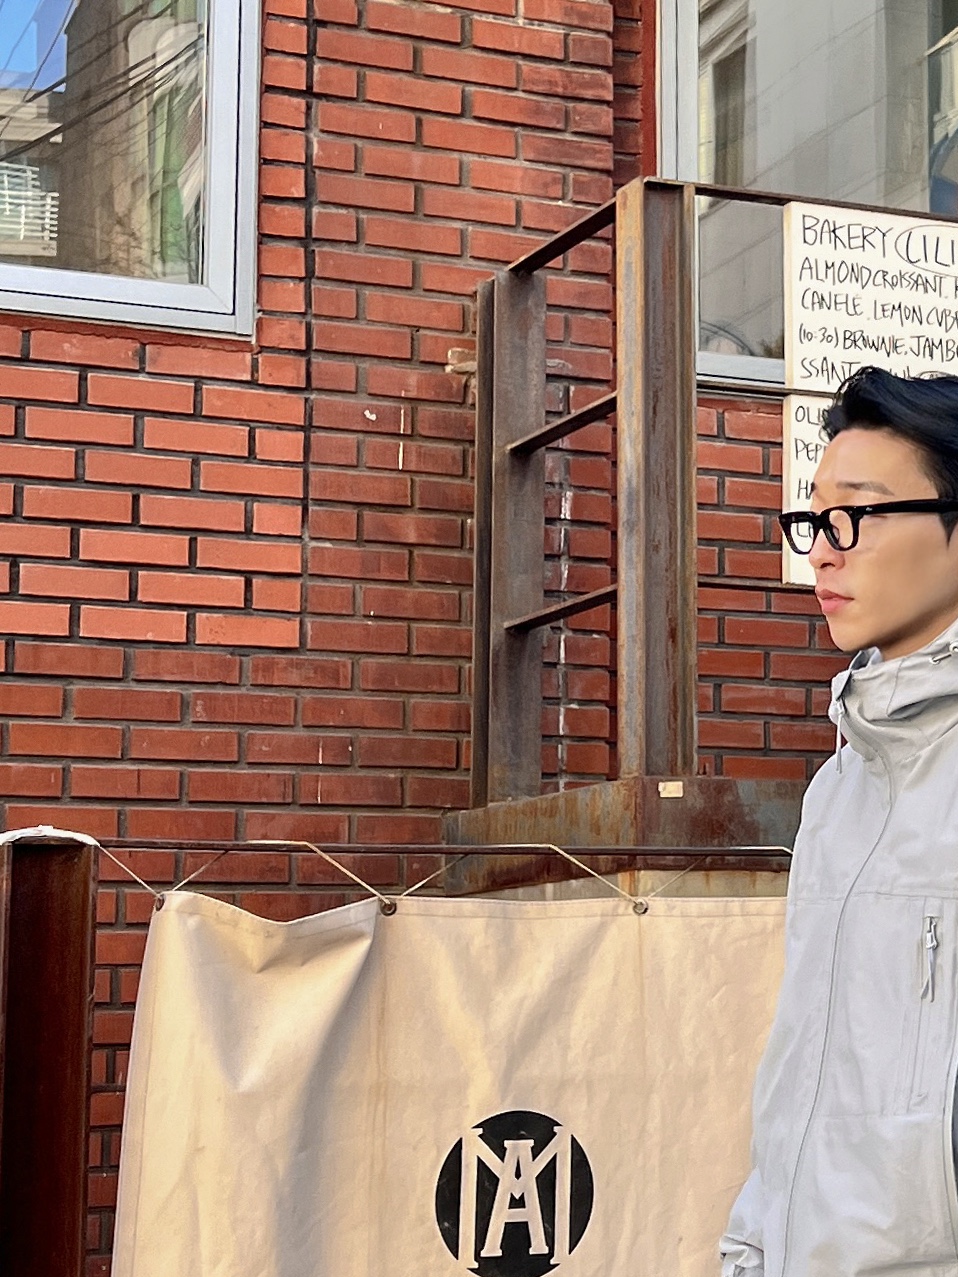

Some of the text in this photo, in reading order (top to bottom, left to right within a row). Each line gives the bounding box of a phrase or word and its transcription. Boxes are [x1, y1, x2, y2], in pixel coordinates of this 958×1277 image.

[802, 214, 894, 258] BAKERY
[799, 256, 872, 290] ALMOND
[873, 299, 923, 327] LEMON
